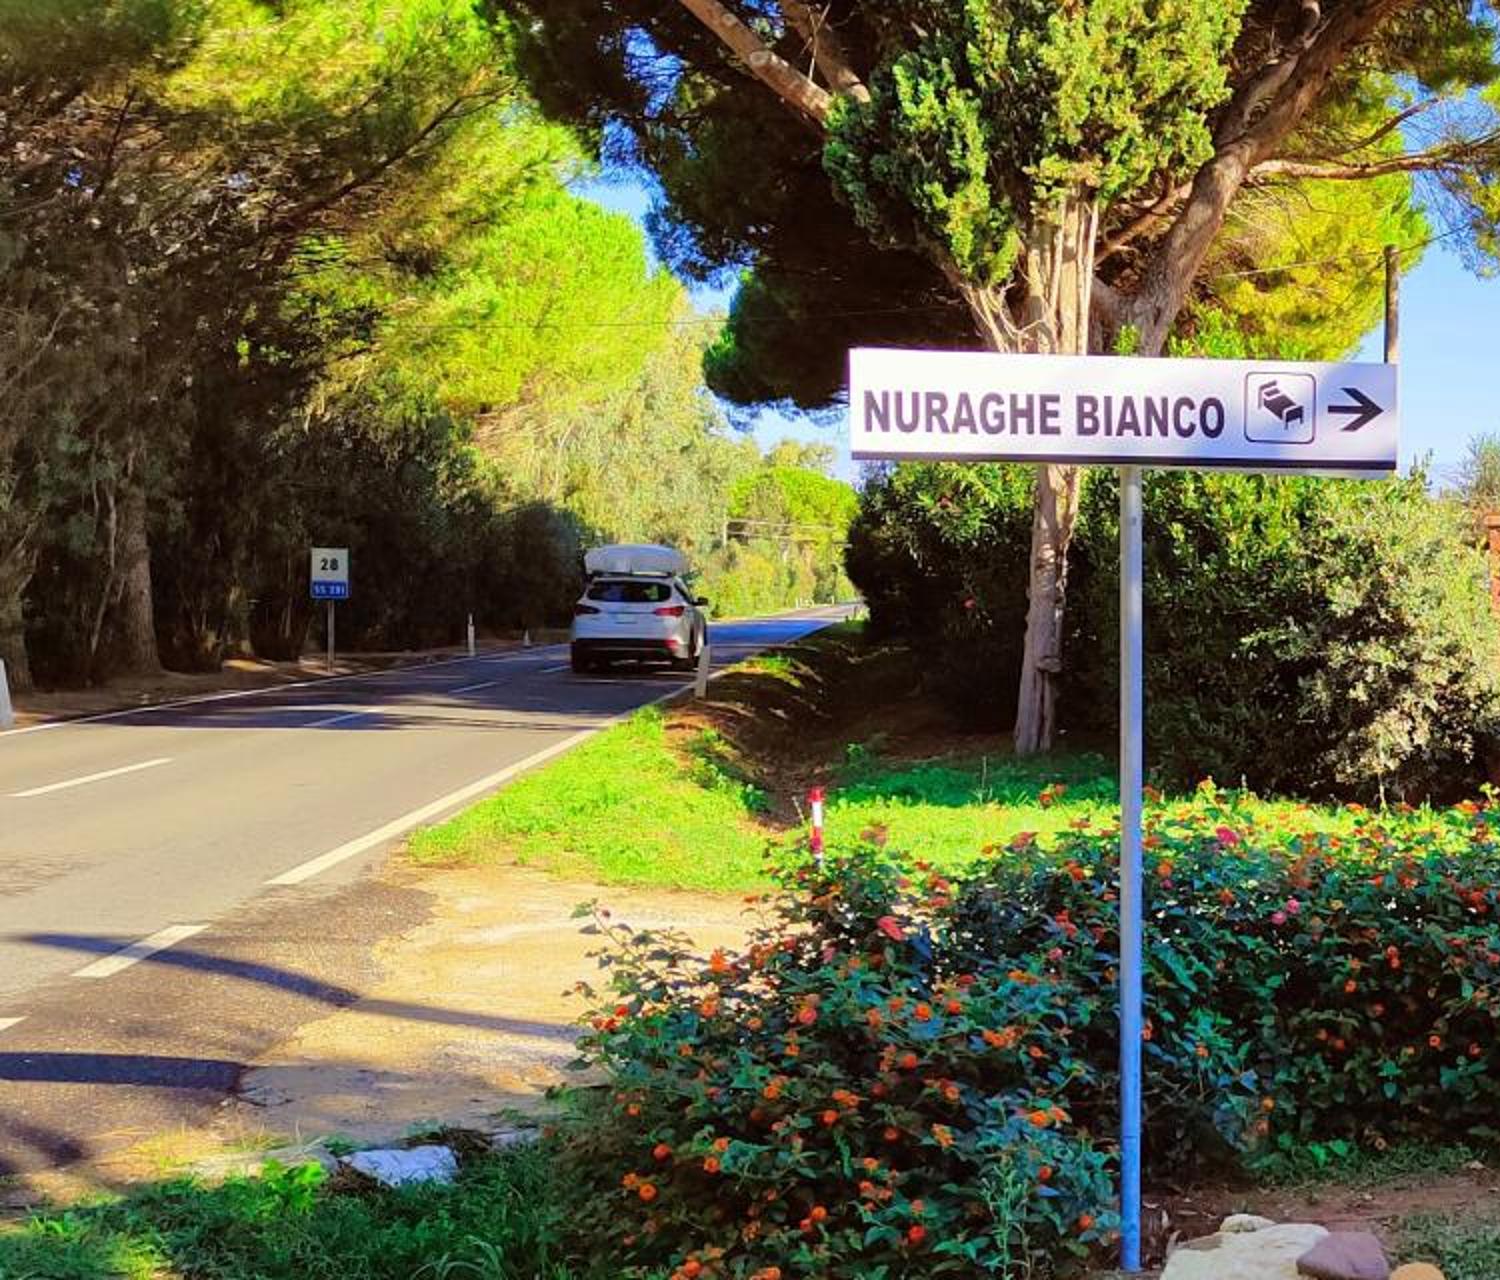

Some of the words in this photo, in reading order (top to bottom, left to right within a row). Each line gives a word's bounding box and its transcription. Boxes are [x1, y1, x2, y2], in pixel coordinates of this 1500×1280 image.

[864, 390, 1062, 436] NURAGHE
[1075, 396, 1226, 438] BIANCO
[320, 557, 339, 571] 28
